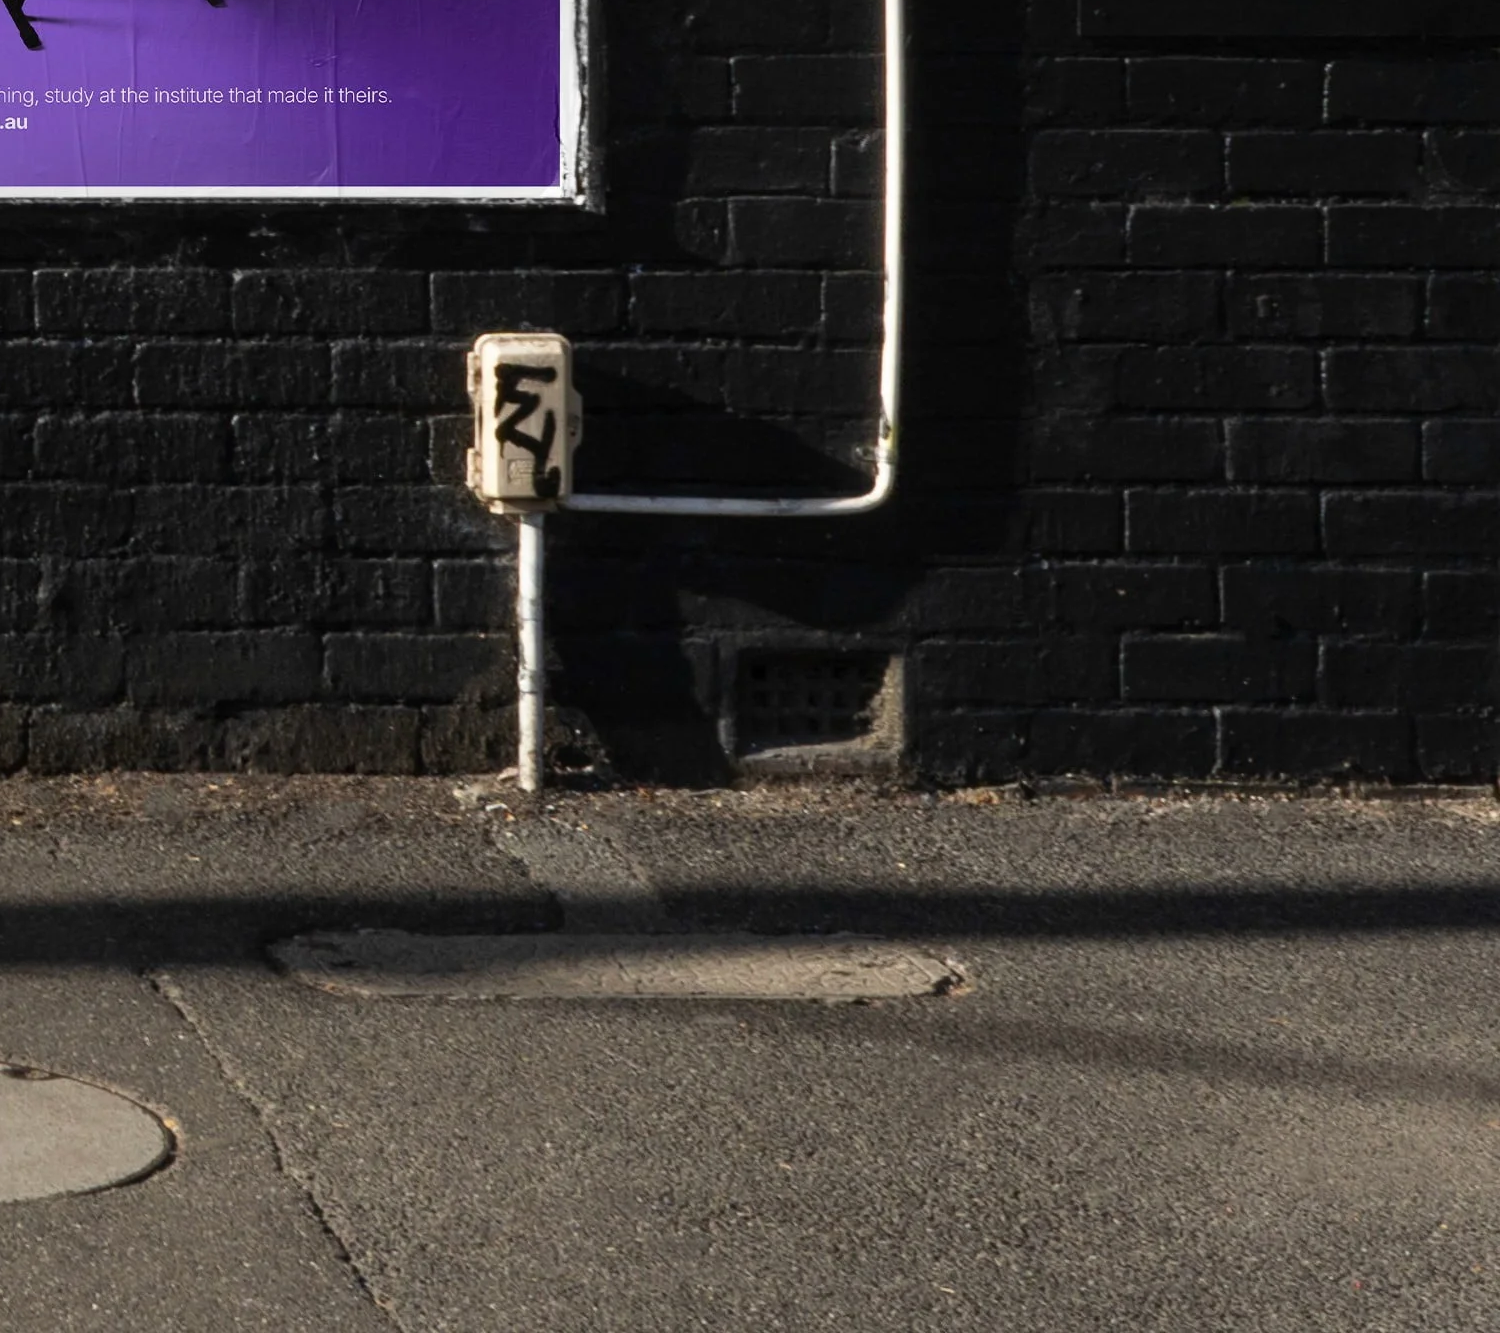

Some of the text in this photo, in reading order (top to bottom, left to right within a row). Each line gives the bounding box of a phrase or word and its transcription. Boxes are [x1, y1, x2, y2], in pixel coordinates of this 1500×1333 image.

[44, 87, 94, 107] study
[99, 89, 116, 103] at
[120, 87, 150, 103] the
[154, 87, 224, 103] institute
[229, 87, 263, 103] that
[268, 87, 319, 103] made
[324, 87, 334, 103] it
[338, 87, 393, 103] theirs.
